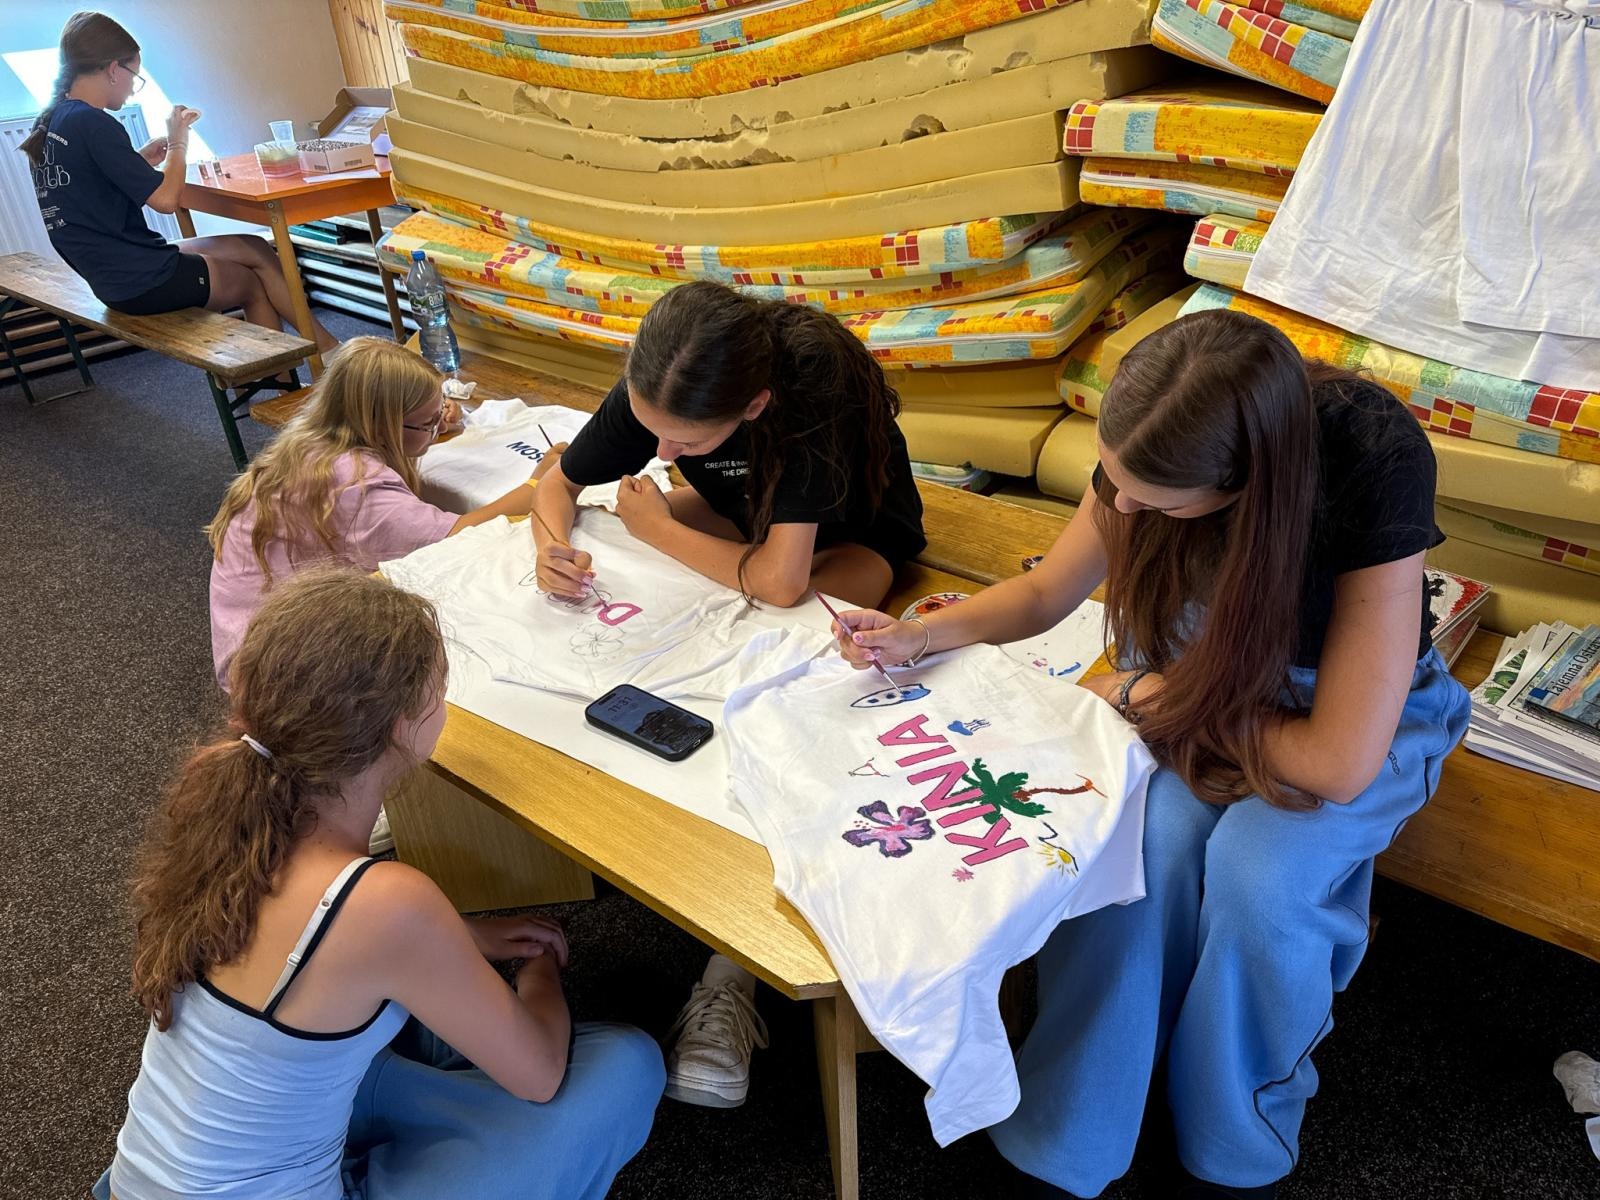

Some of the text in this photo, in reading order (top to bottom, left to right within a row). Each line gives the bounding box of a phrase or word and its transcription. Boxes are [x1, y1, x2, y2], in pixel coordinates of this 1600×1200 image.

[704, 460, 730, 469] CREATE
[721, 468, 751, 477] THE DRE
[1544, 661, 1584, 697] Tajemná
[1573, 636, 1600, 664] Ostrav
[877, 714, 1029, 866] KINIA
